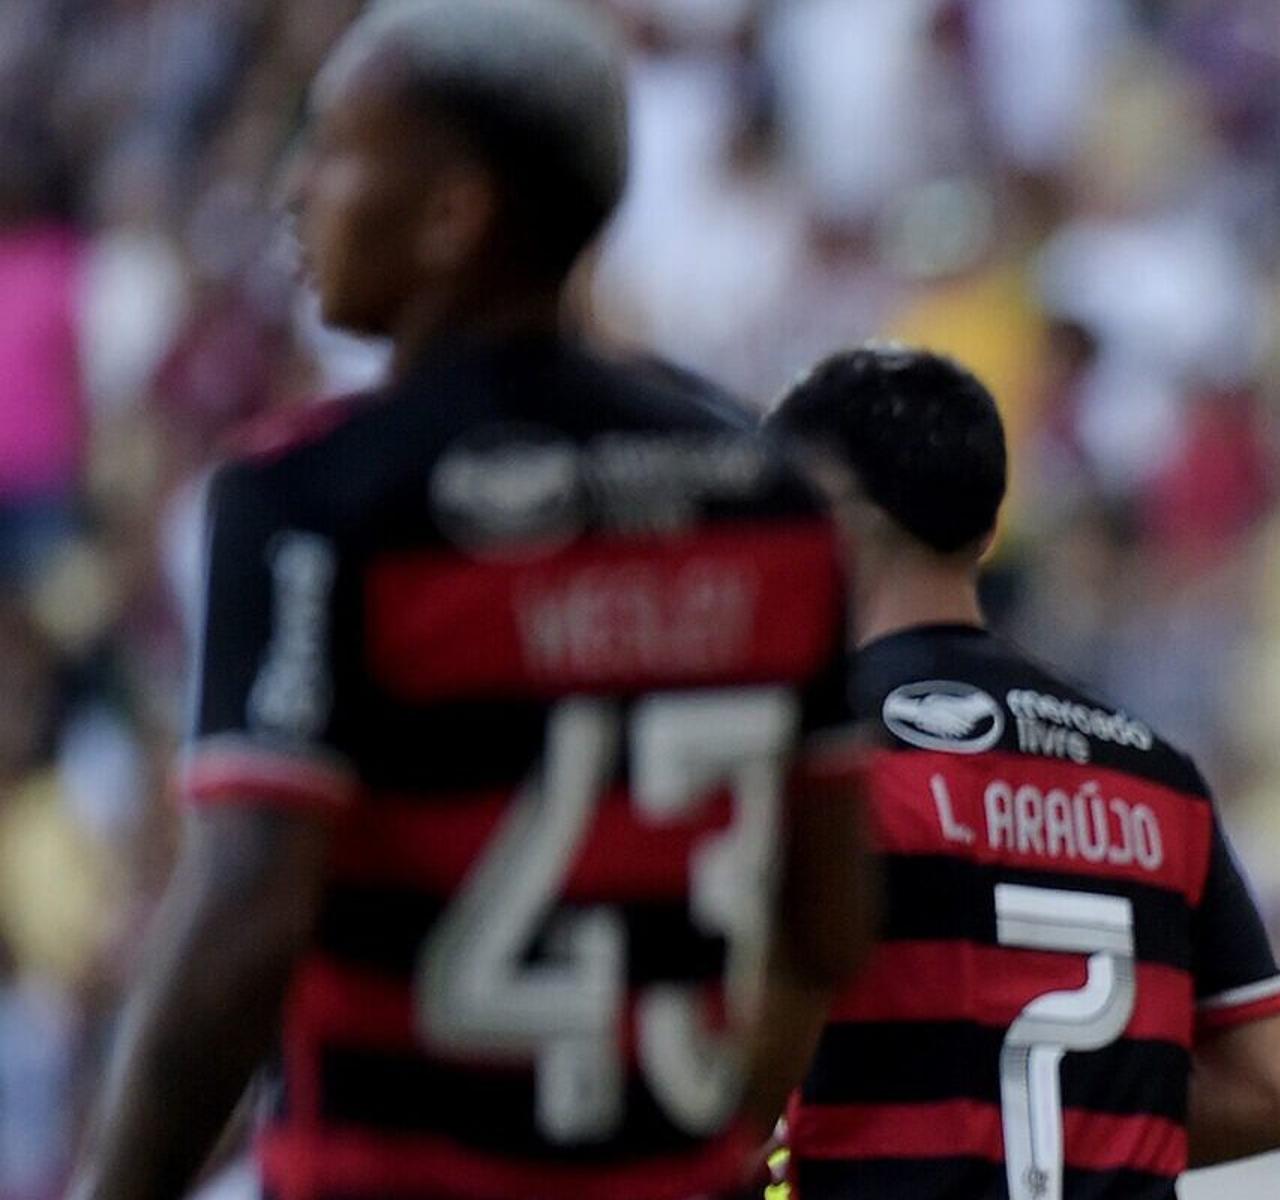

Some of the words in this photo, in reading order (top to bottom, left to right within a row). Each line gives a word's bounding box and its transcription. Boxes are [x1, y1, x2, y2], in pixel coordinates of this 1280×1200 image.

[1006, 688, 1152, 750] mercado
[1017, 714, 1090, 764] livre
[930, 773, 976, 845] L.
[984, 778, 1163, 871] ARAÚJO
[412, 684, 800, 1143] 43
